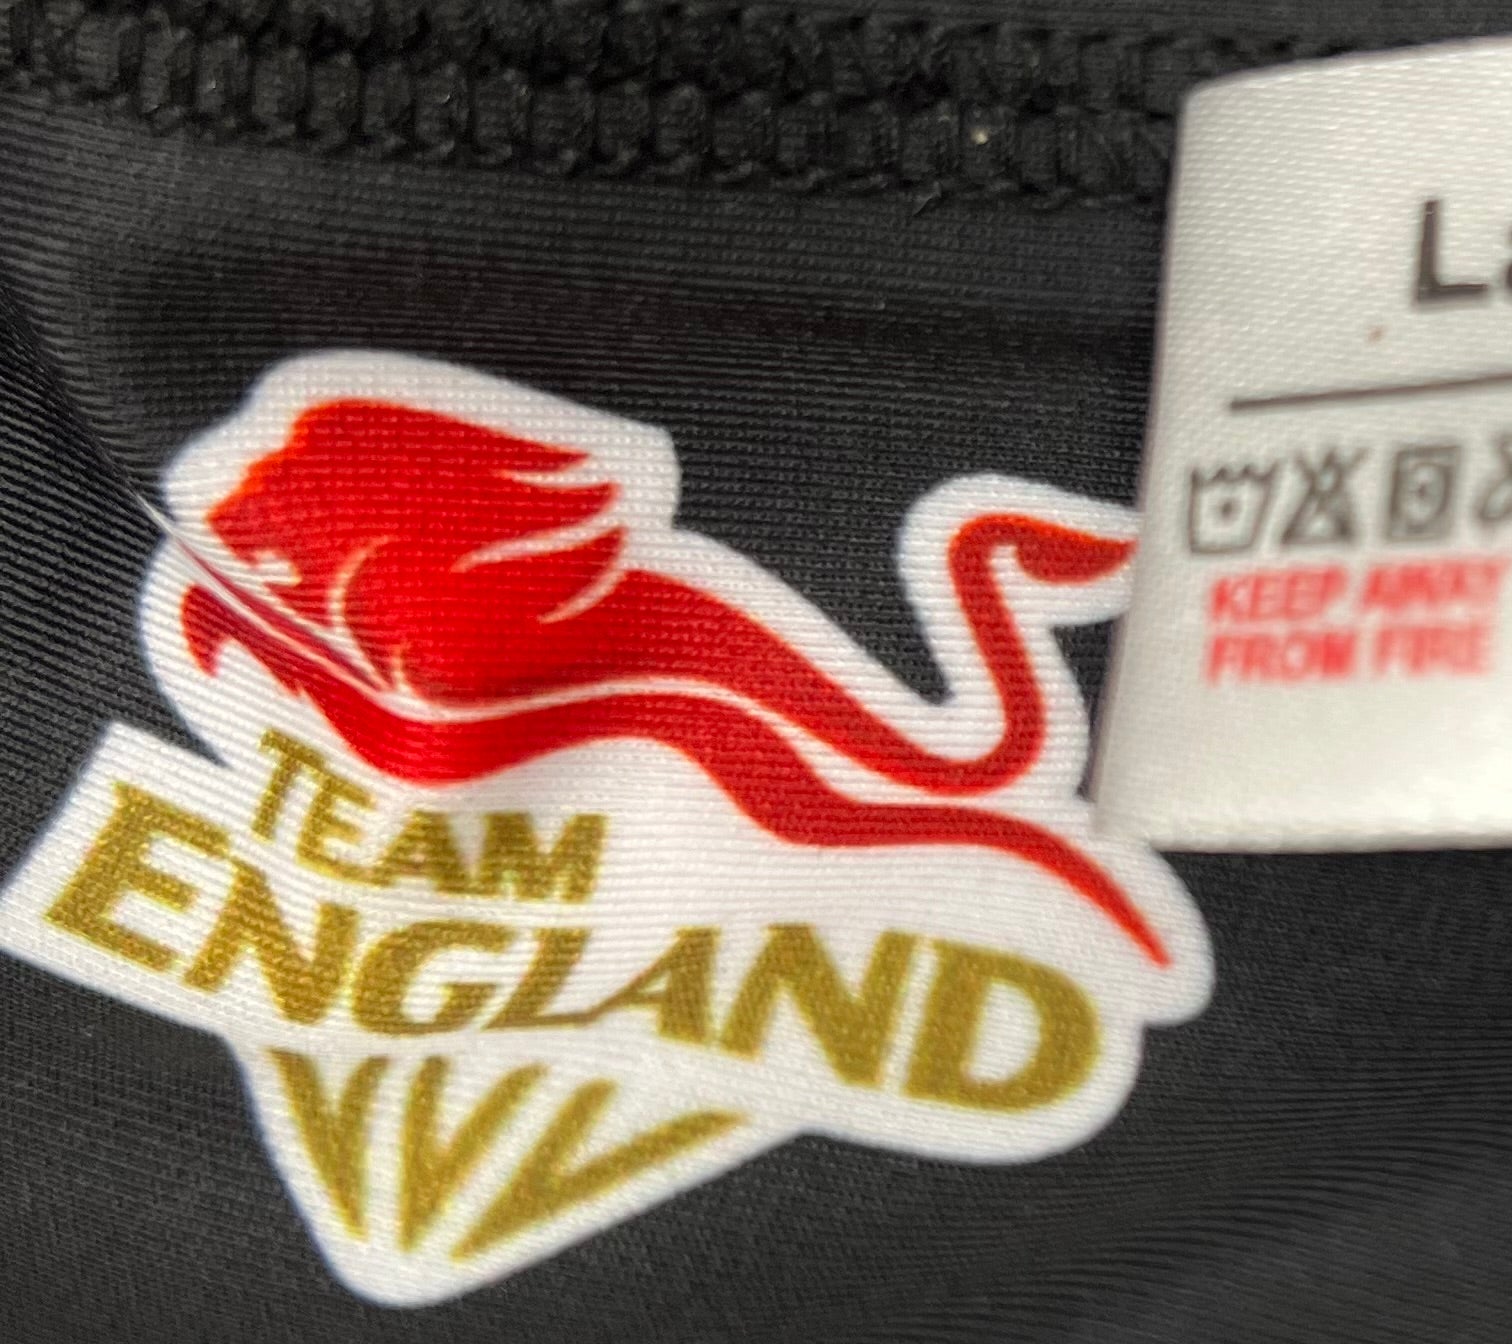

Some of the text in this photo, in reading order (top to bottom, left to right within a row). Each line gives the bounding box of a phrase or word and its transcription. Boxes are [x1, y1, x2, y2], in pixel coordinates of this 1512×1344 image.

[1210, 564, 1346, 621] KEEP
[252, 730, 608, 906] TEAM
[44, 780, 1102, 1114] ENGLAND
